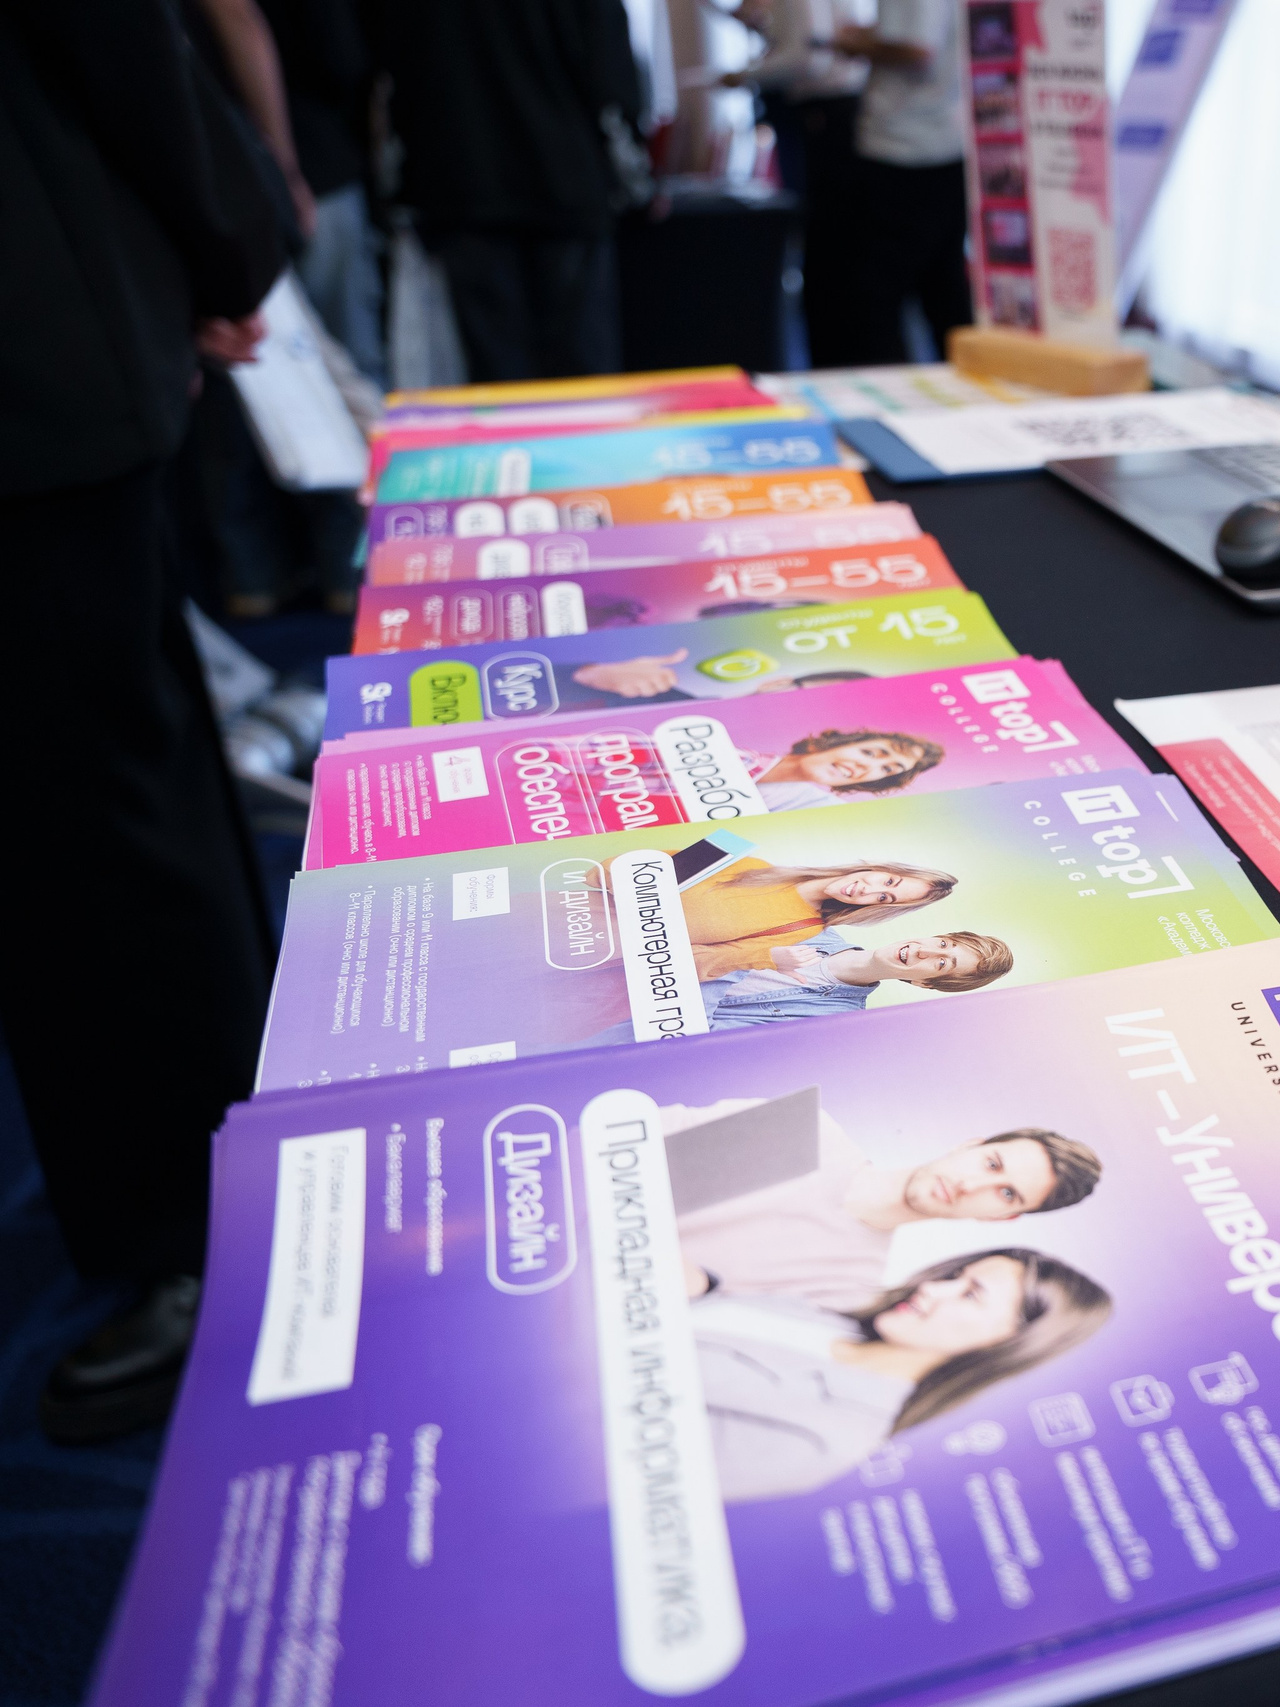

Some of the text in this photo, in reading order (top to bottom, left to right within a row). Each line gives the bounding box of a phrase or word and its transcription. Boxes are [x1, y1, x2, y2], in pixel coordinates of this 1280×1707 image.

[784, 624, 857, 653] ОТ
[879, 605, 960, 640] 15
[494, 661, 543, 712] Курс
[930, 682, 1000, 754] COLLEGE
[990, 701, 1050, 746] top
[669, 723, 751, 822] Разрабо
[1024, 800, 1097, 898] COLLEGE
[1091, 825, 1158, 885] top
[406, 885, 417, 921] дипломом
[422, 893, 435, 912] базе
[425, 881, 435, 894] На
[558, 869, 605, 957] и дизайн
[350, 889, 376, 1027] Параллельно школе для обучающихся
[381, 886, 404, 1027] образовании (очно или дистанционно)
[403, 927, 415, 959] среднем
[418, 941, 429, 966] класса
[421, 919, 431, 934] или
[630, 862, 679, 1002] Компьютерная
[1176, 911, 1211, 950] колледж
[1195, 908, 1231, 949] Московс
[330, 891, 361, 1035] 8-11 классов (очно или дистанционно)
[399, 959, 412, 1033] профессиональном
[415, 970, 428, 1042] государственным
[496, 1131, 560, 1275] Дизайн
[598, 1119, 661, 1334] Прикладная
[627, 1343, 703, 1652] информатика
